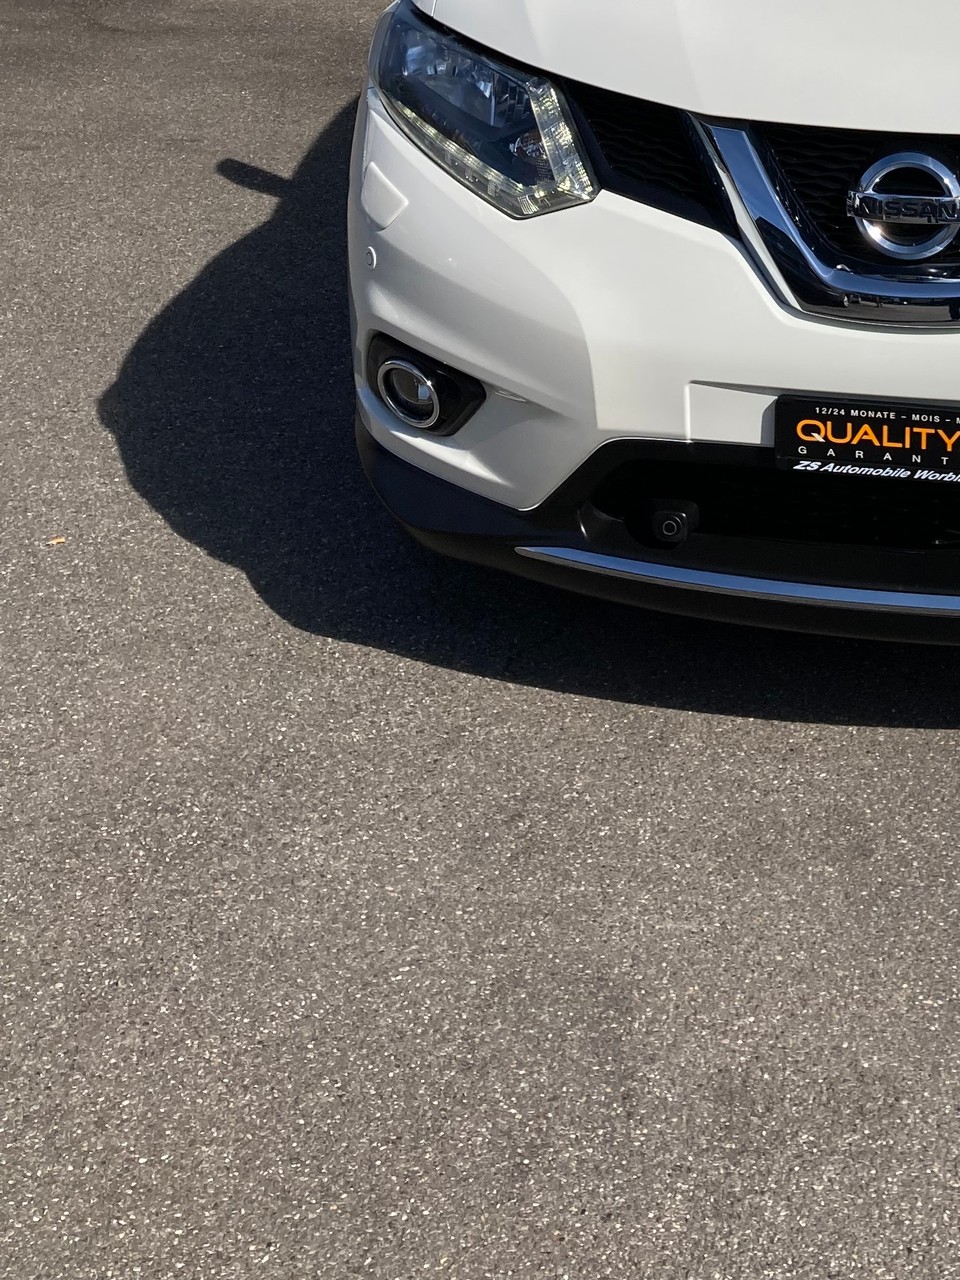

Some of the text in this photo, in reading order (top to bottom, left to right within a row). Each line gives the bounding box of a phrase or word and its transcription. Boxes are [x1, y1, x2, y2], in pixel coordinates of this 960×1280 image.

[857, 197, 958, 220] NISSAN
[815, 406, 846, 416] 12/24
[850, 409, 896, 420] MONATE
[911, 413, 940, 423] MOIS
[793, 460, 823, 471] ZS
[819, 463, 912, 479] Automobile
